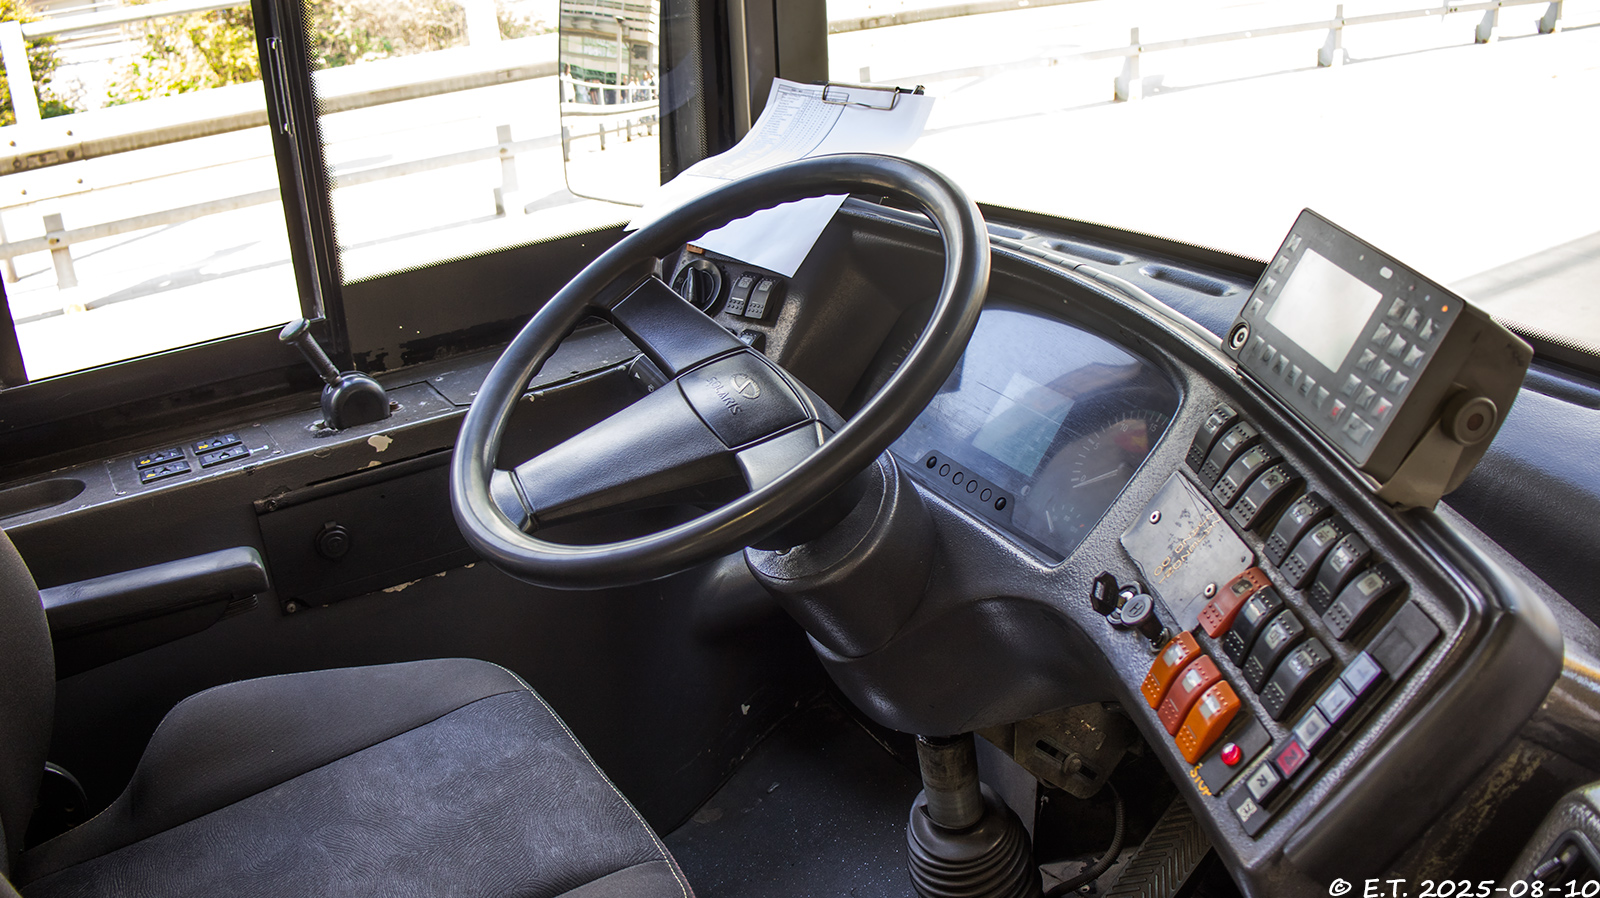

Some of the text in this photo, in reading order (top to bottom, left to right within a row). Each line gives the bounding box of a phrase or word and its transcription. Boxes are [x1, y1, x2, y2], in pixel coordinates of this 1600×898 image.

[706, 376, 743, 415] SOLARIS
[1283, 749, 1298, 765] N
[1256, 774, 1268, 787] R
